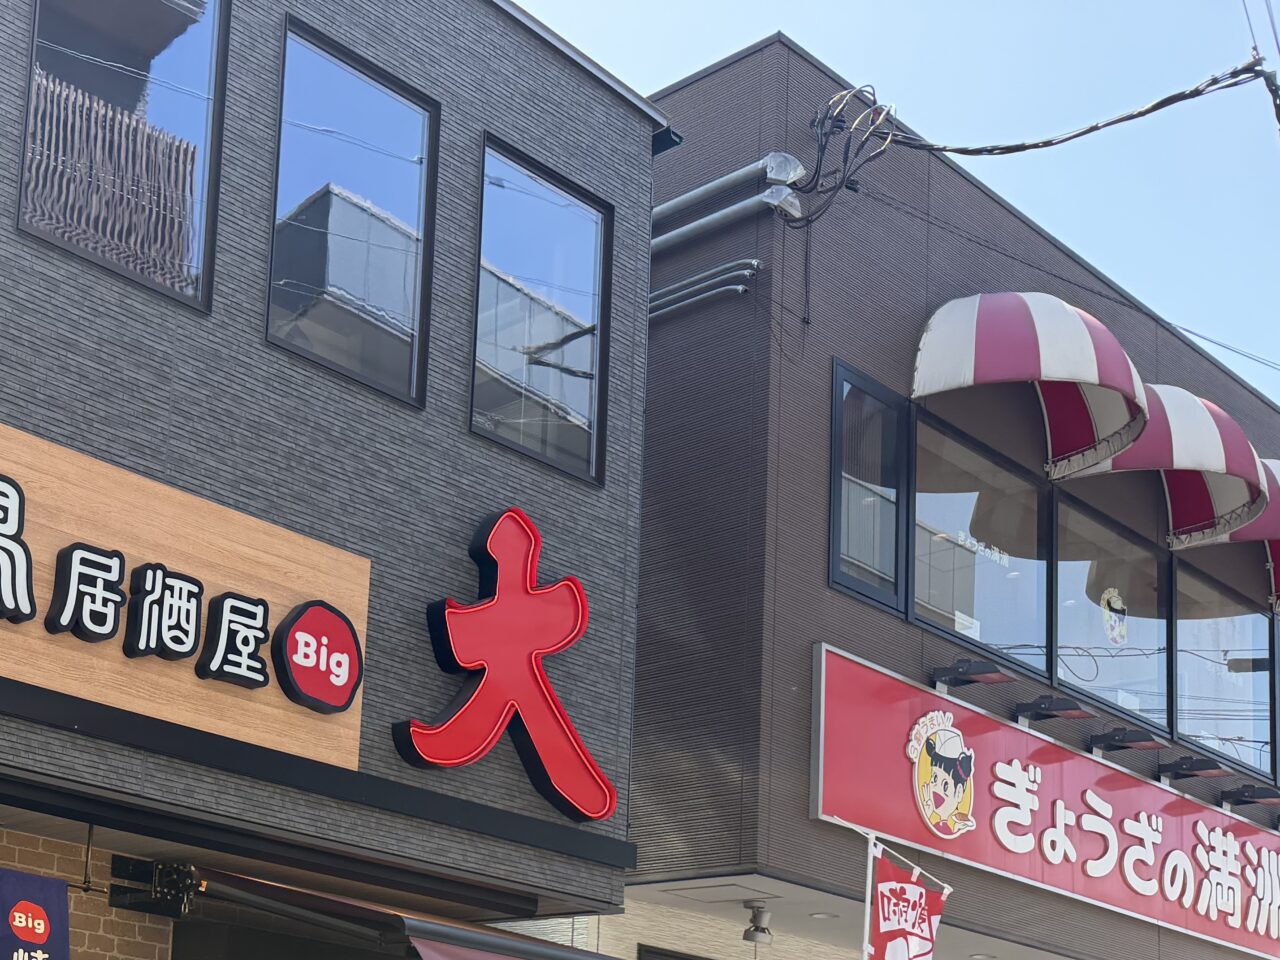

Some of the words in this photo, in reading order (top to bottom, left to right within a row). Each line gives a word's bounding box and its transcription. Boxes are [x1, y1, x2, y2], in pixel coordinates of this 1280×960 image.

[291, 630, 350, 688] Big
[397, 506, 618, 821] 大
[990, 757, 1280, 940] ぎょうざの満洲
[12, 911, 46, 934] Big
